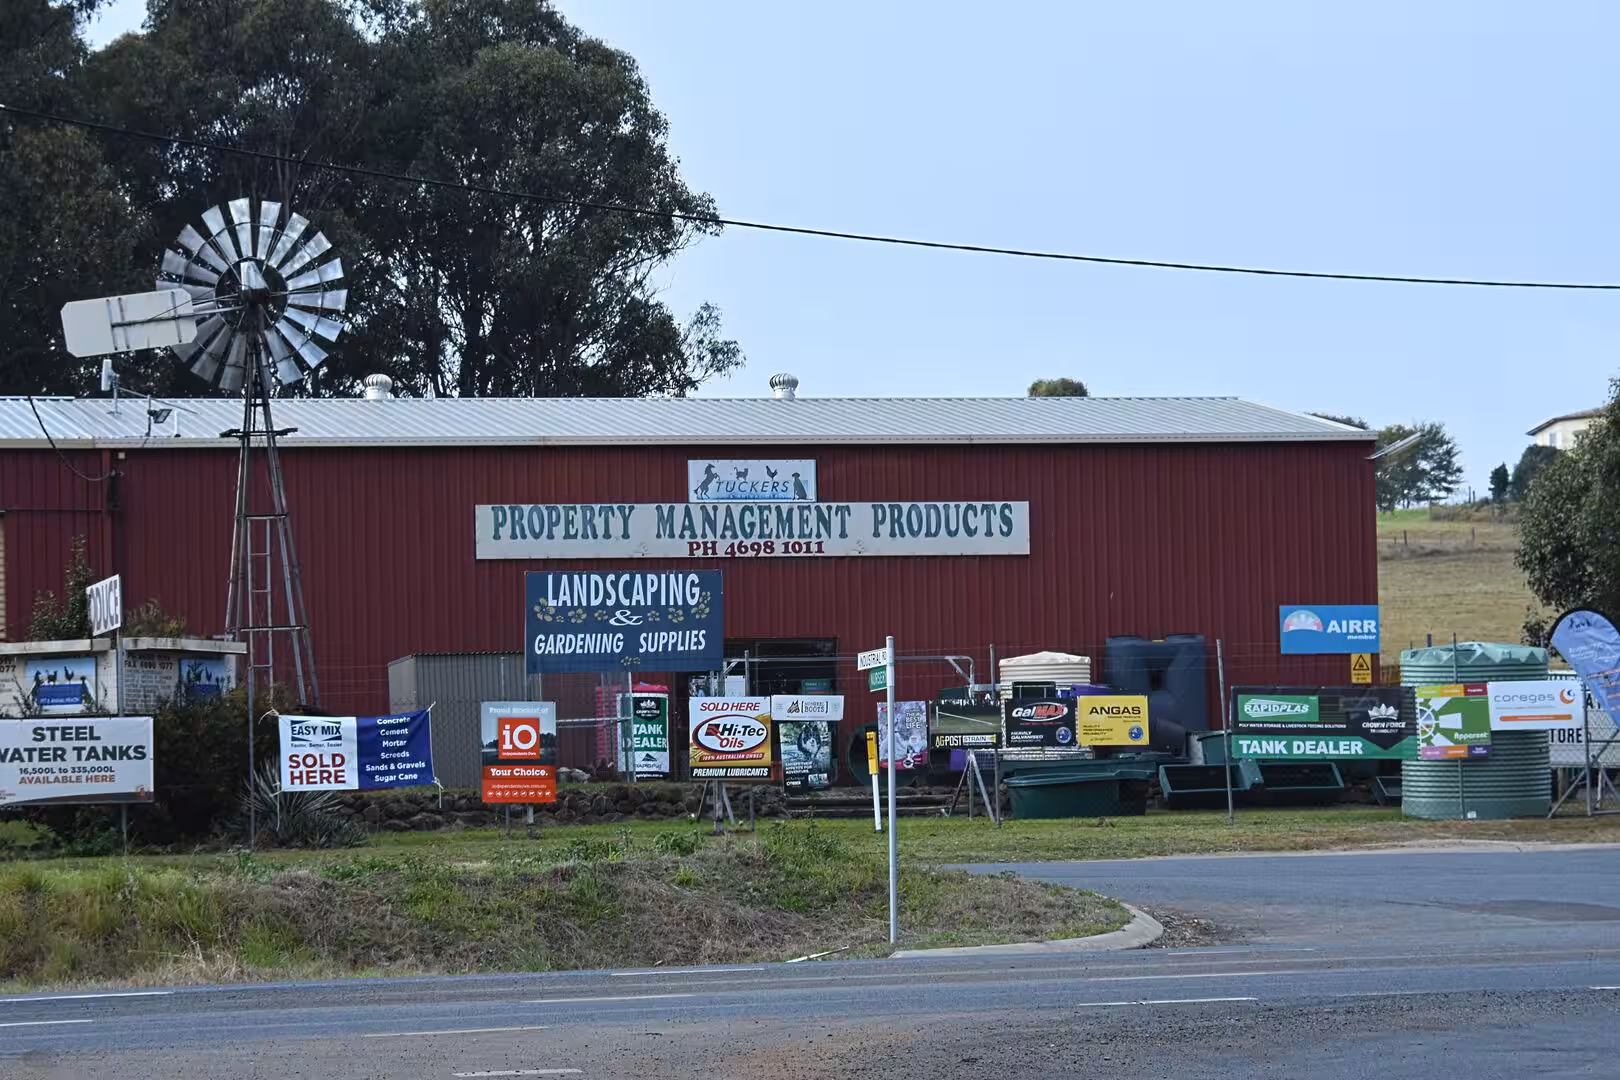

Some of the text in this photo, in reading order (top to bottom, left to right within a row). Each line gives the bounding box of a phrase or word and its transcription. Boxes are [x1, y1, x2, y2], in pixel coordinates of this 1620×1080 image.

[716, 481, 789, 493] TUCKERS
[491, 503, 1014, 541] PROPERTY MANAGEMENT PRODUCTS
[687, 540, 825, 558] PH 4698 1011
[547, 573, 701, 606] LANDSCAPING
[609, 609, 643, 626] &
[1326, 619, 1376, 633] AIRR
[534, 630, 706, 654] GARDENING SUPPLIES
[1493, 693, 1555, 704] coregas
[700, 703, 760, 711] SOLD HERE
[1089, 706, 1141, 715] ANGAS
[1244, 703, 1310, 713] RAPIDPLAS
[376, 717, 411, 725] Concrete
[32, 726, 101, 742] STEEL
[291, 725, 341, 735] EASY MIX
[380, 728, 409, 736] Cement
[633, 724, 663, 735] TANK
[720, 723, 765, 736] Hi-Tec
[502, 724, 537, 750] iO
[719, 738, 745, 748] Oils
[1238, 740, 1363, 755] TANK DEALER
[72, 745, 147, 762] TANKS
[380, 750, 410, 759] Screeds
[288, 753, 346, 769] SOLD
[397, 761, 426, 769] Gravels
[19, 767, 56, 775] 16,500L
[70, 766, 115, 774] 335,000L
[490, 768, 548, 776] Your Choice.
[693, 768, 769, 777] PREMIUM LUBRICANTS
[18, 774, 115, 784] AVAILABLE HERE
[290, 769, 347, 785] HERE
[374, 775, 397, 783] Sugar
